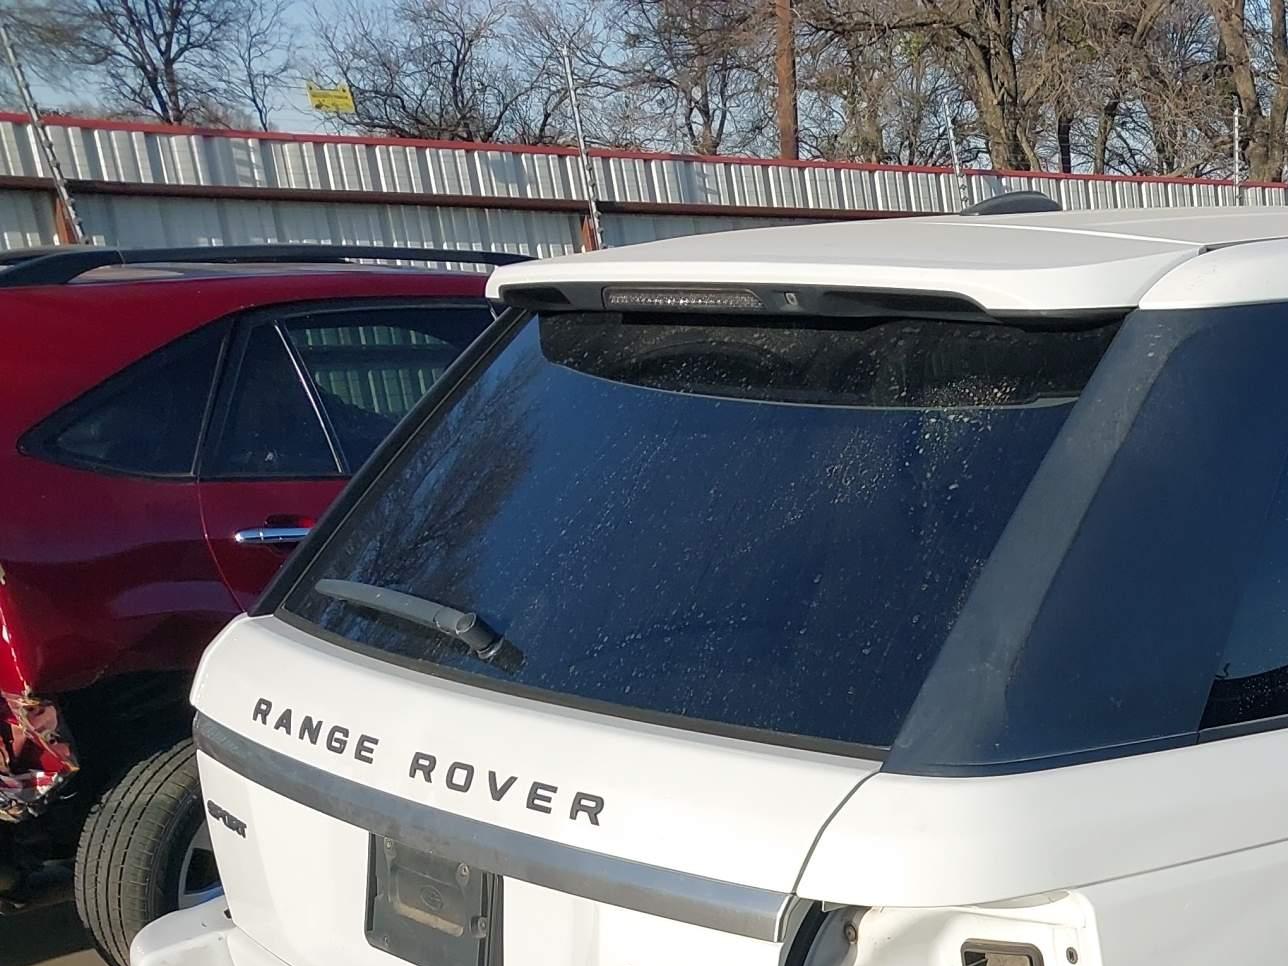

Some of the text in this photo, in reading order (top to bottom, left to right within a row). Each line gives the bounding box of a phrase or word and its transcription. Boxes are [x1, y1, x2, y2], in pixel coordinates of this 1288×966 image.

[252, 697, 606, 826] RANGE ROVER
[206, 799, 248, 839] SPORT
